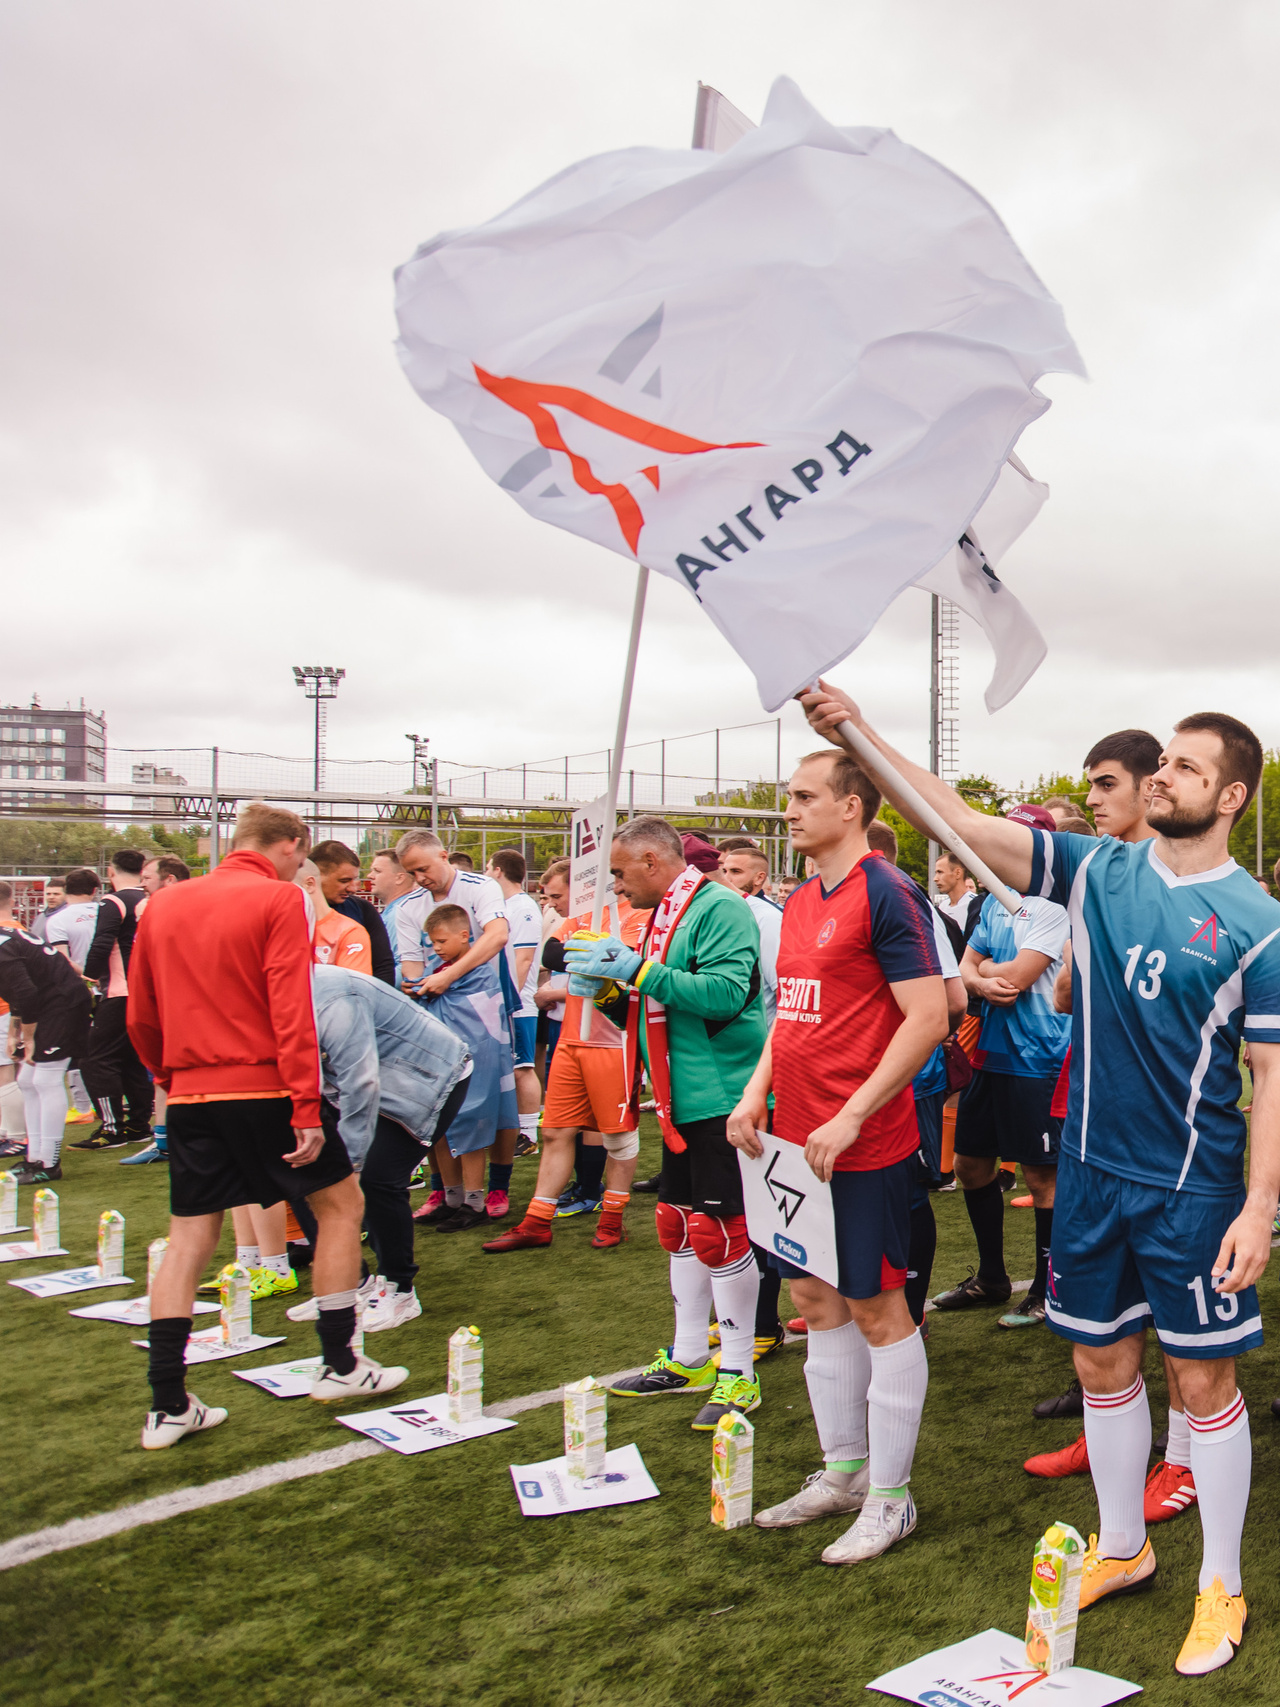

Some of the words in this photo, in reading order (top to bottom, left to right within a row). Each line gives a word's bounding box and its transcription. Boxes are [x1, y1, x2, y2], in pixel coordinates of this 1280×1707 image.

[1180, 946, 1218, 966] АВАНГАРД
[1124, 944, 1167, 1000] 13
[799, 1012, 822, 1024] КЛУБ
[617, 1103, 627, 1123] 7
[1187, 1269, 1239, 1326] 13
